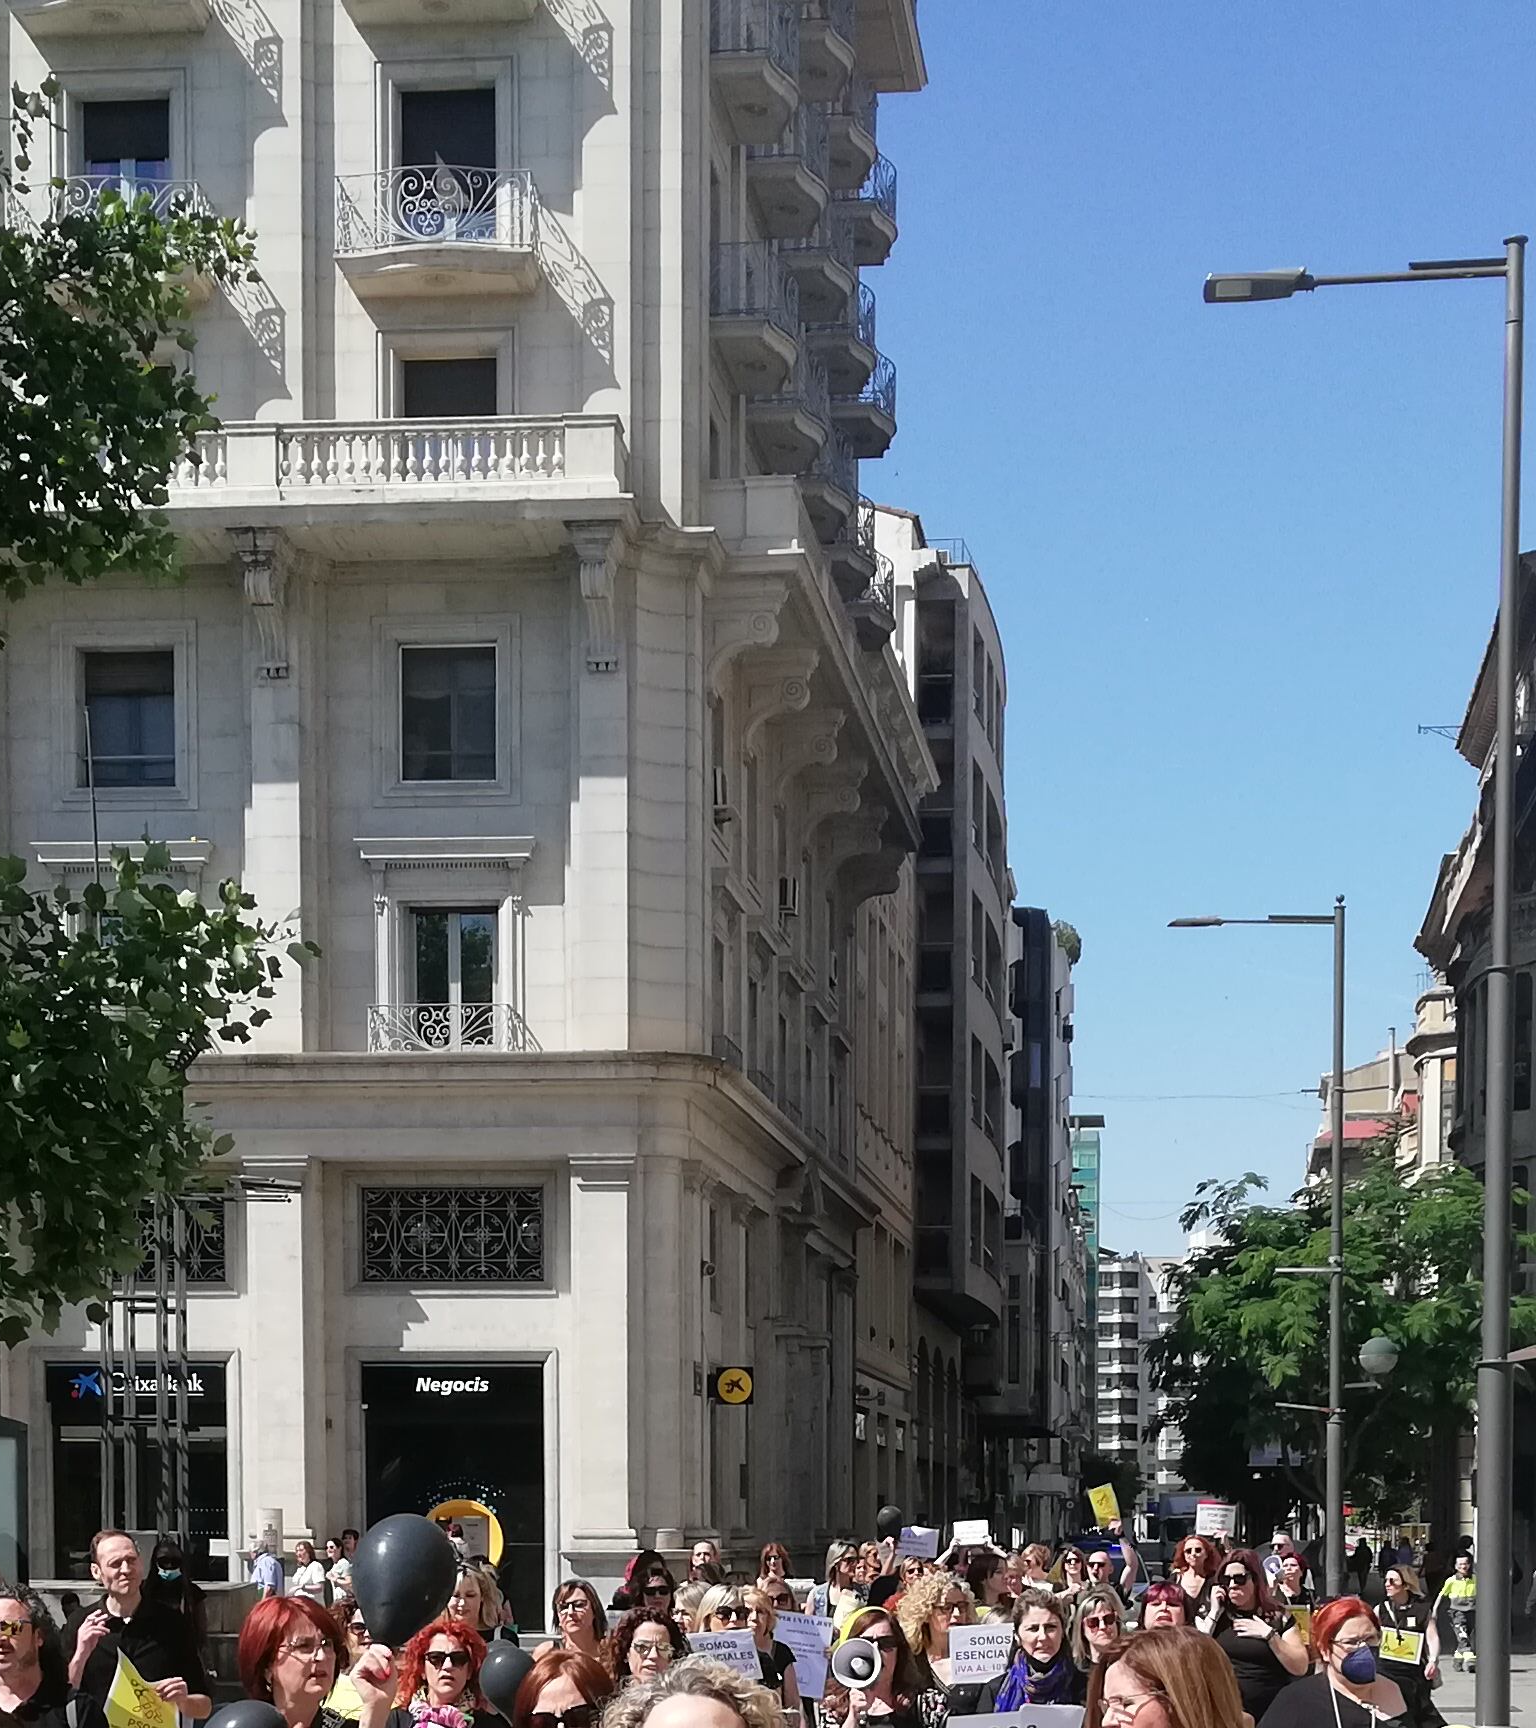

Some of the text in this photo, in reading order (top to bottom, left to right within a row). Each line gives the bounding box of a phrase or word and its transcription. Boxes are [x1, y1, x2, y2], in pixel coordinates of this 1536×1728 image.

[113, 1372, 204, 1393] CixaBank
[415, 1376, 489, 1396] Negocis
[698, 1640, 738, 1652] SOMOS
[969, 1636, 1011, 1646] SOMOS
